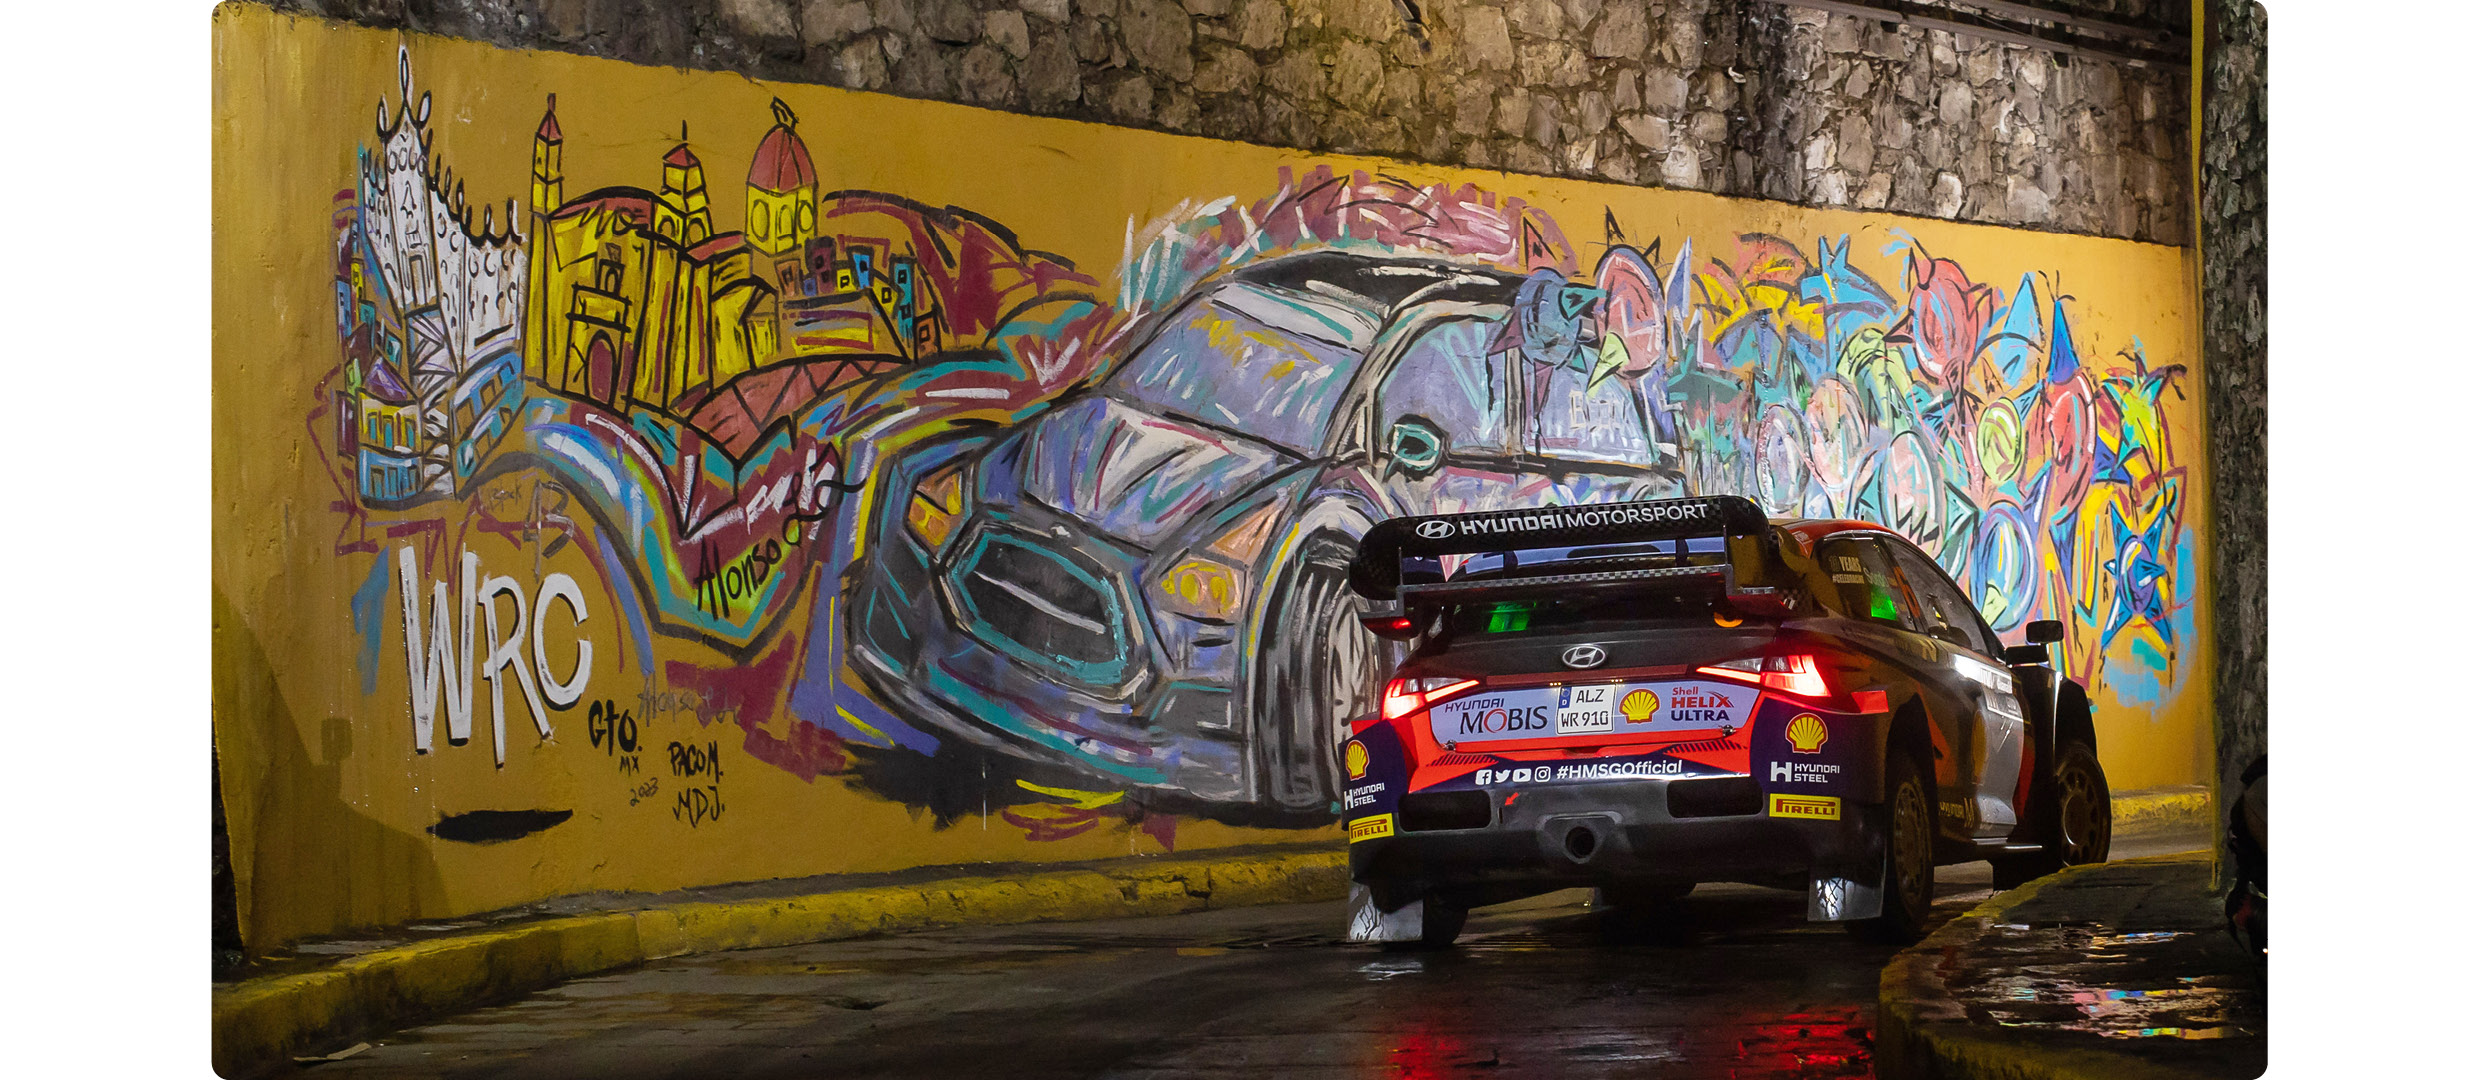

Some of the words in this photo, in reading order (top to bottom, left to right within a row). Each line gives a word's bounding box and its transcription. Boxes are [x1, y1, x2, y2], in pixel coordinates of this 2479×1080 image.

[1461, 515, 1563, 535] HYUNDAI
[1565, 503, 1708, 528] MOTORSPORT
[1839, 556, 1862, 573] YEARS
[693, 534, 781, 621] Alonso
[399, 543, 593, 772] WRC
[1576, 689, 1605, 704] ALZ
[1672, 686, 1699, 696] Shell
[1445, 698, 1505, 714] HYUNDAI
[1561, 699, 1568, 707] D
[1672, 694, 1731, 709] HELIX
[1459, 706, 1549, 736] MOBIS
[1561, 711, 1579, 727] WR
[1582, 710, 1609, 727] 910
[1671, 709, 1730, 722] ULTRA
[1557, 760, 1683, 779] #HMSGOfficial
[1794, 763, 1841, 774] HYUNDAI
[1794, 773, 1829, 784] STEEL
[1353, 782, 1386, 797] HYUNDAI
[1354, 794, 1377, 806] STEEL
[1776, 798, 1836, 816] PIRELLI
[1350, 818, 1388, 839] PIRELLI
